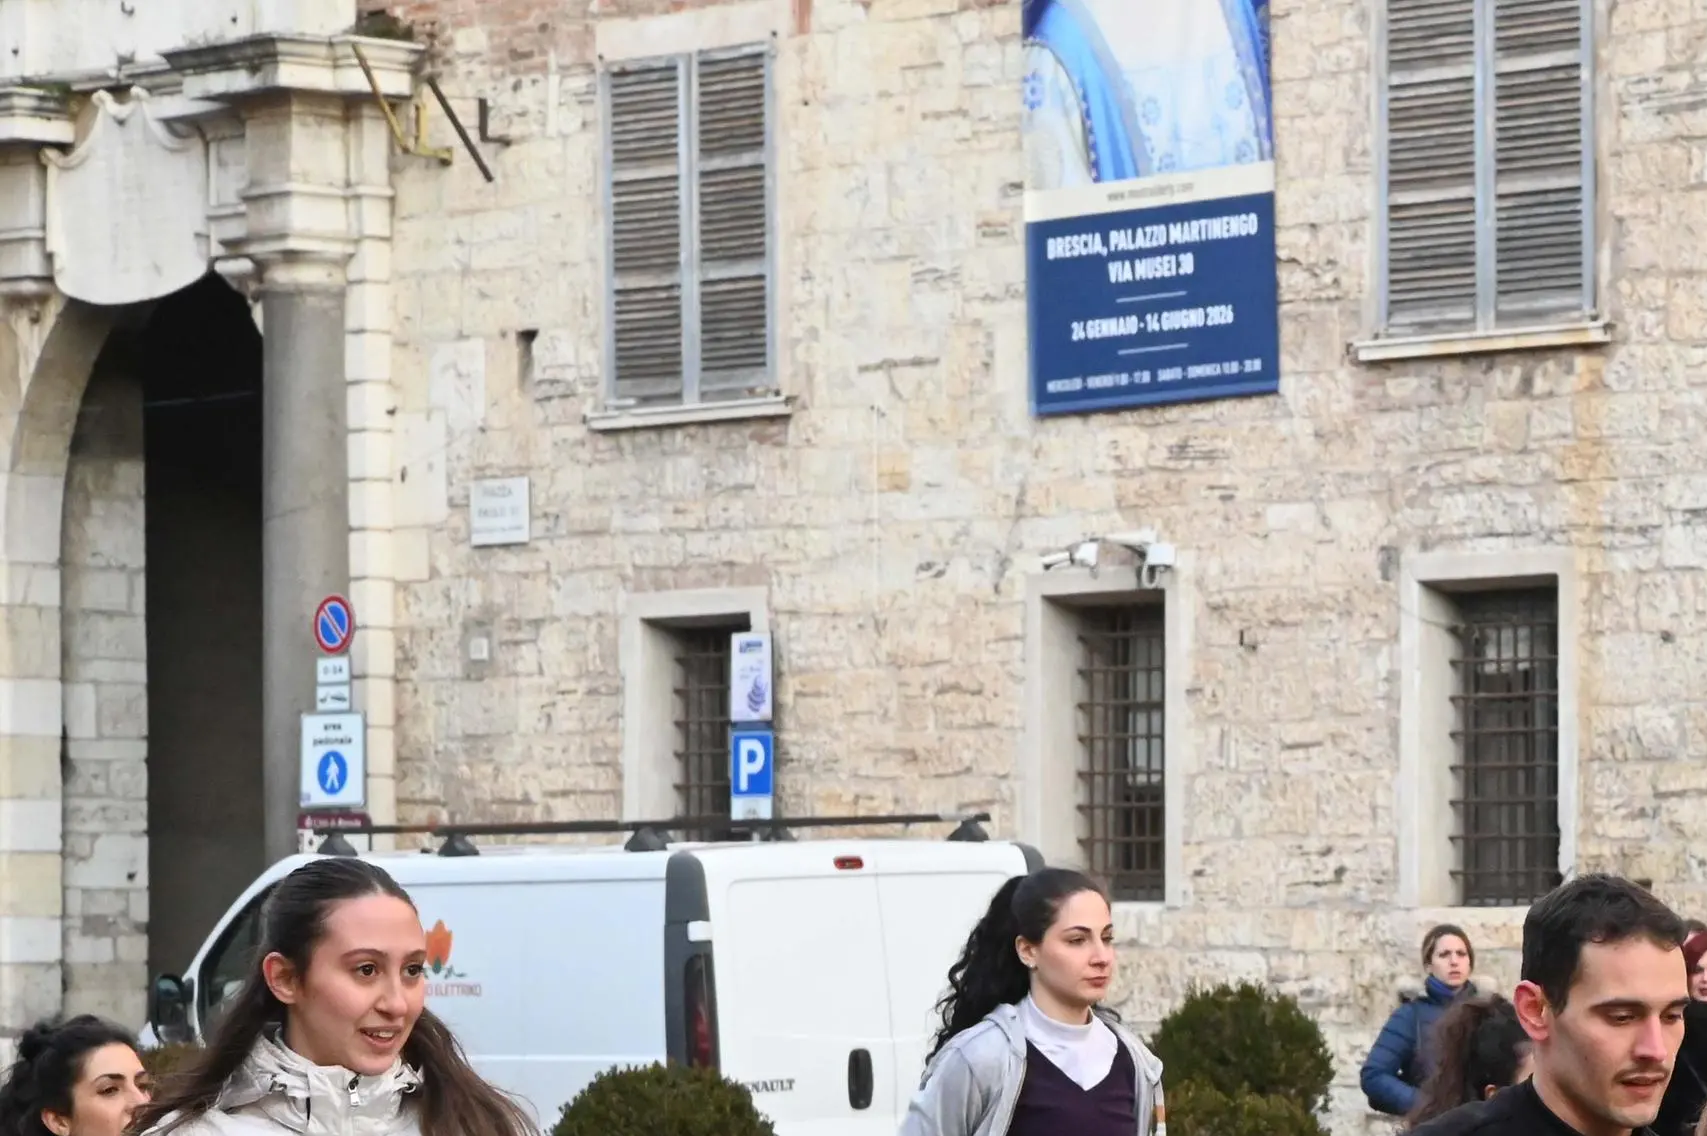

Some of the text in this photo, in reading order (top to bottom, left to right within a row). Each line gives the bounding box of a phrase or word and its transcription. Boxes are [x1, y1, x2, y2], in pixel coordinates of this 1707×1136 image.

[1047, 212, 1259, 260] BRESCIA, PALAZZO MARTINENGO
[1108, 252, 1194, 283] VIA MUSEI 30
[1071, 321, 1086, 342] 24
[1086, 315, 1139, 340] GENNAIO
[1146, 313, 1160, 333] 14
[1161, 308, 1205, 331] GIUGNO
[739, 738, 766, 792] P
